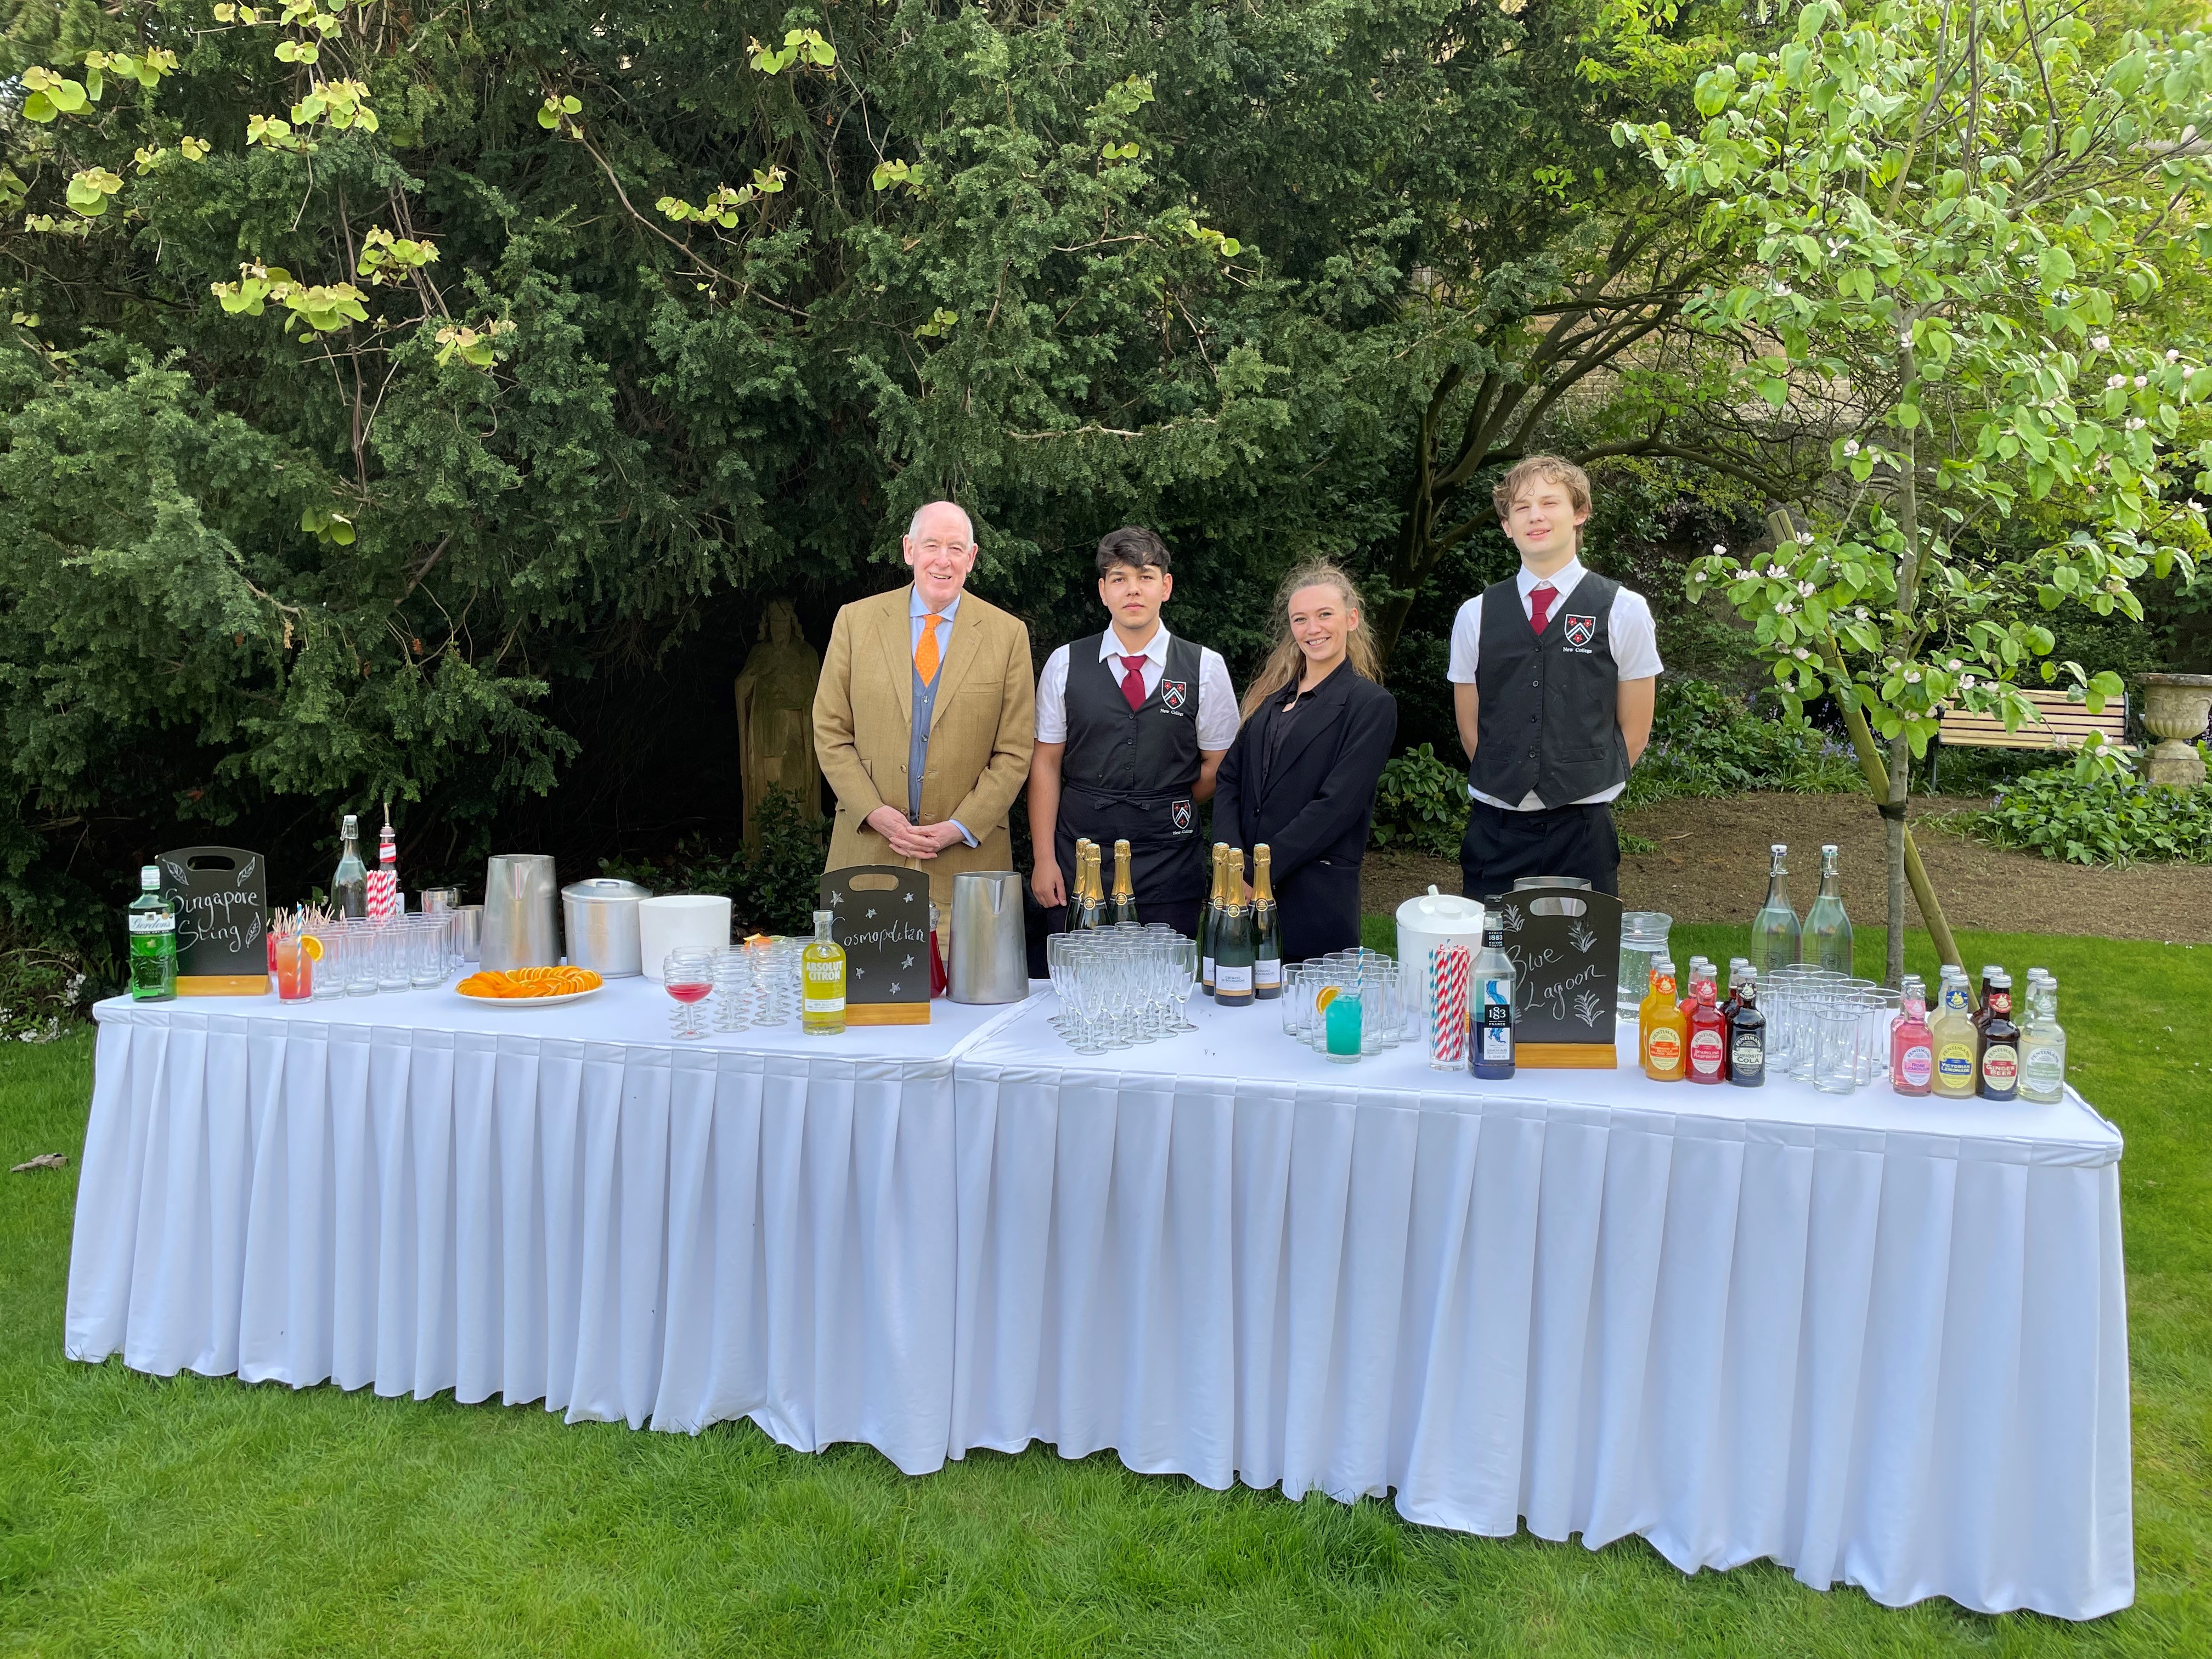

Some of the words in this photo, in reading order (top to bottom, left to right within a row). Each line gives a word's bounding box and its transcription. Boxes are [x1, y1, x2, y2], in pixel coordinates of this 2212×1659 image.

[166, 888, 259, 932] Singapore
[806, 961, 843, 972] ABSOLUT
[809, 970, 840, 981] CITRON
[1524, 964, 1607, 1020] Lagoon
[1652, 1030, 1678, 1041] FENTIMANS
[1695, 1032, 1719, 1044] FENTIMANS
[1735, 1036, 1762, 1047] FENTIMANS
[1942, 1046, 1970, 1058] FENTIMANS
[1988, 1048, 2015, 1060] FENTIMANS
[2030, 1050, 2059, 1063] FENTIMANS
